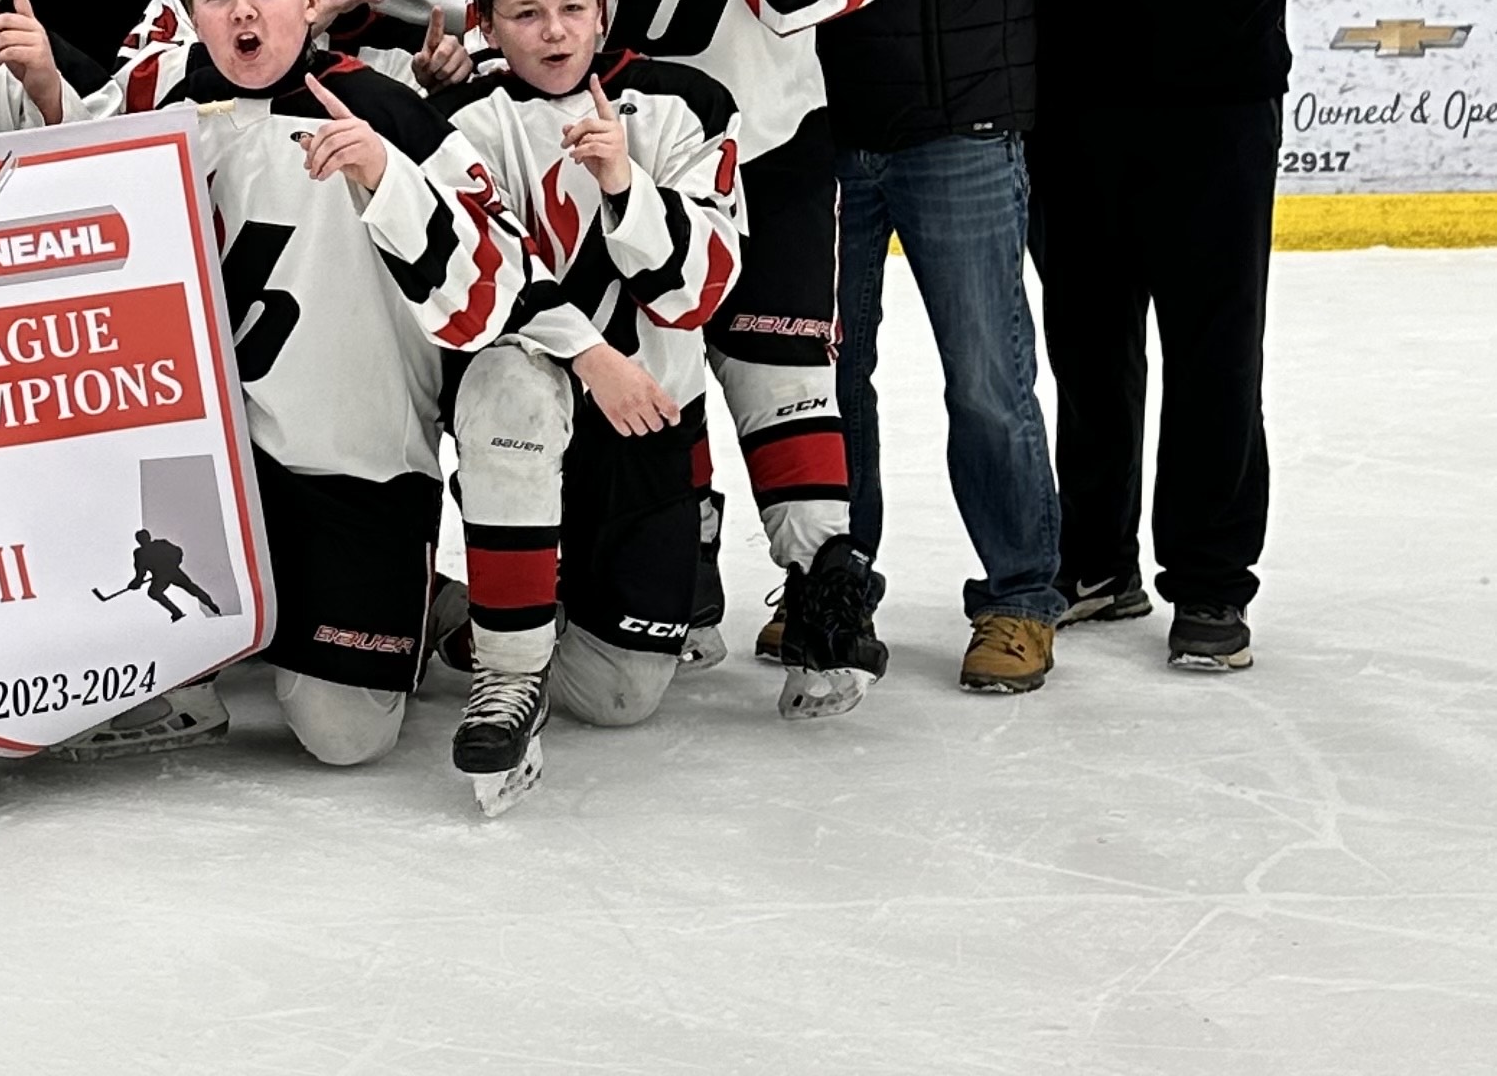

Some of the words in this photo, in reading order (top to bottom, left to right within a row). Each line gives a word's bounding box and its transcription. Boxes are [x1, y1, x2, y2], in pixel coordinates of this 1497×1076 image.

[1293, 92, 1403, 133] Owned
[1410, 89, 1432, 124] &
[729, 314, 832, 339] BAUER
[776, 397, 828, 416] CCM
[490, 437, 545, 453] BAUER
[619, 614, 690, 638] CCM
[313, 624, 416, 655] BAUER
